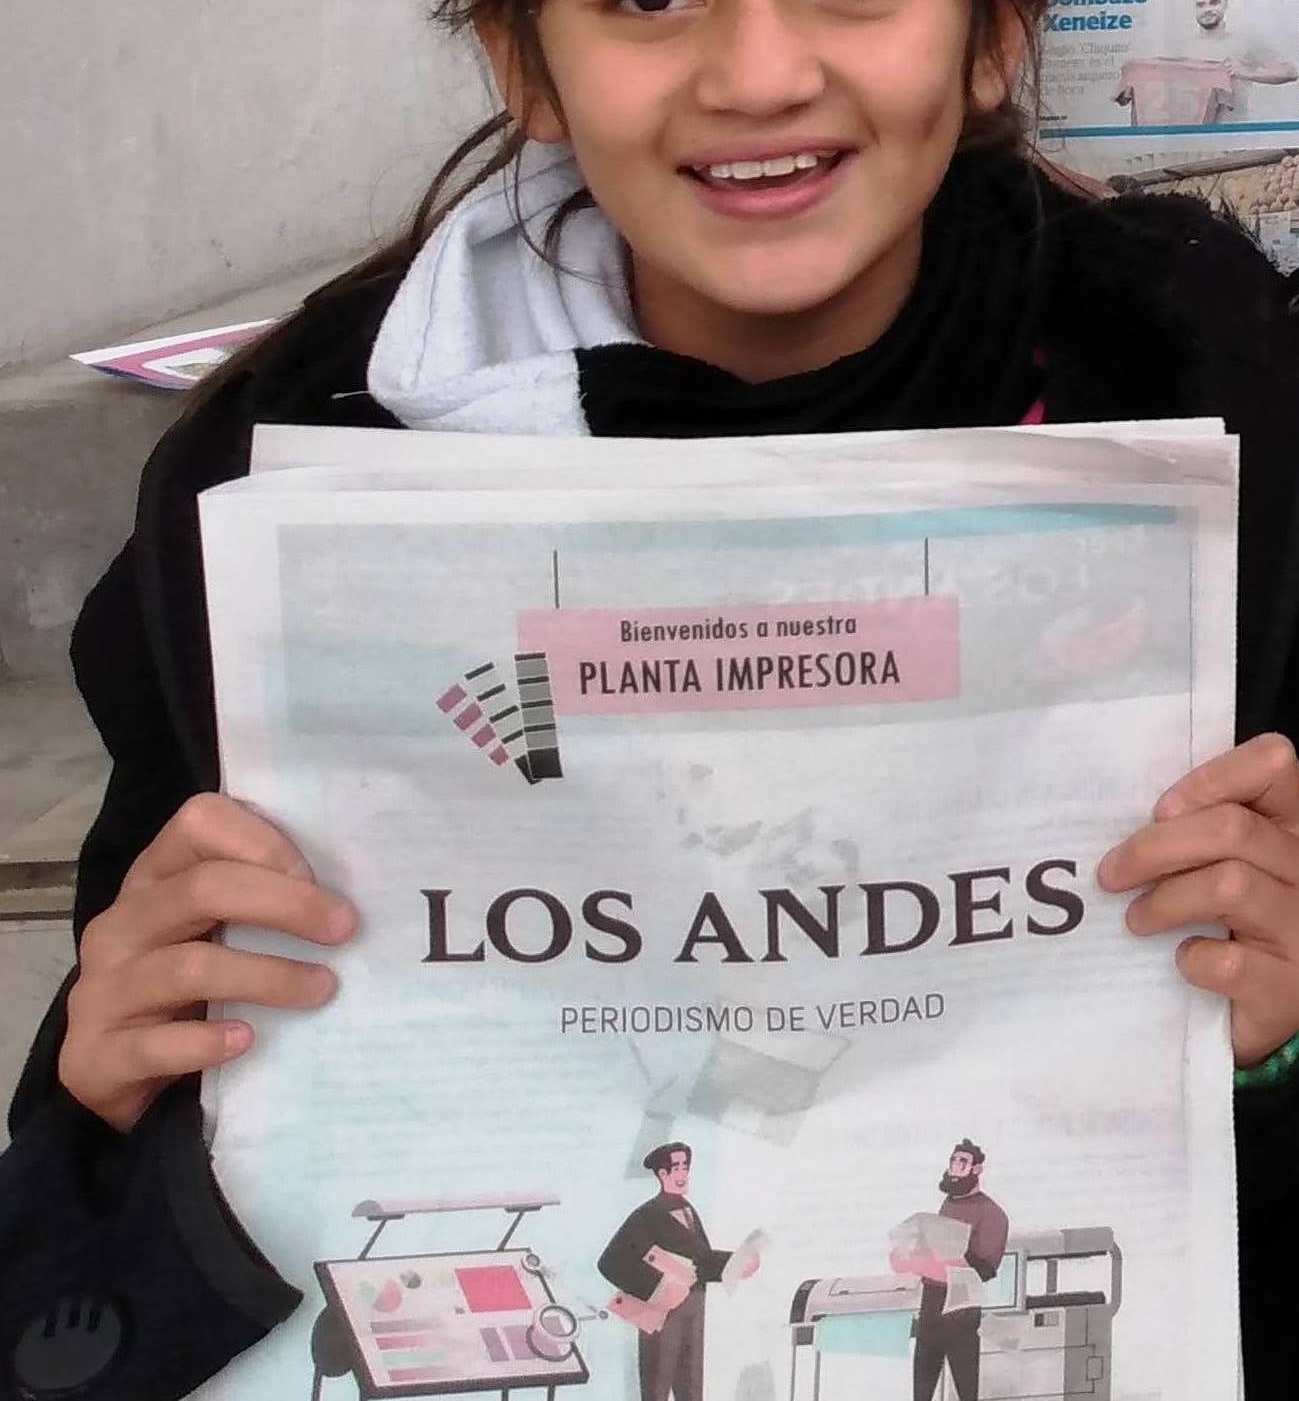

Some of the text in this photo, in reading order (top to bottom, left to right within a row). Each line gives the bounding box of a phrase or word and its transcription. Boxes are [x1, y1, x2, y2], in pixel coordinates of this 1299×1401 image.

[1043, 11, 1133, 32] Xeneize
[619, 613, 857, 644] Bienvenidos a nuestra
[579, 649, 901, 696] PLANTA IMPRESORA
[420, 858, 1085, 964] LOS ANDES
[560, 992, 946, 1035] PERIODISMO DE VERDAD
